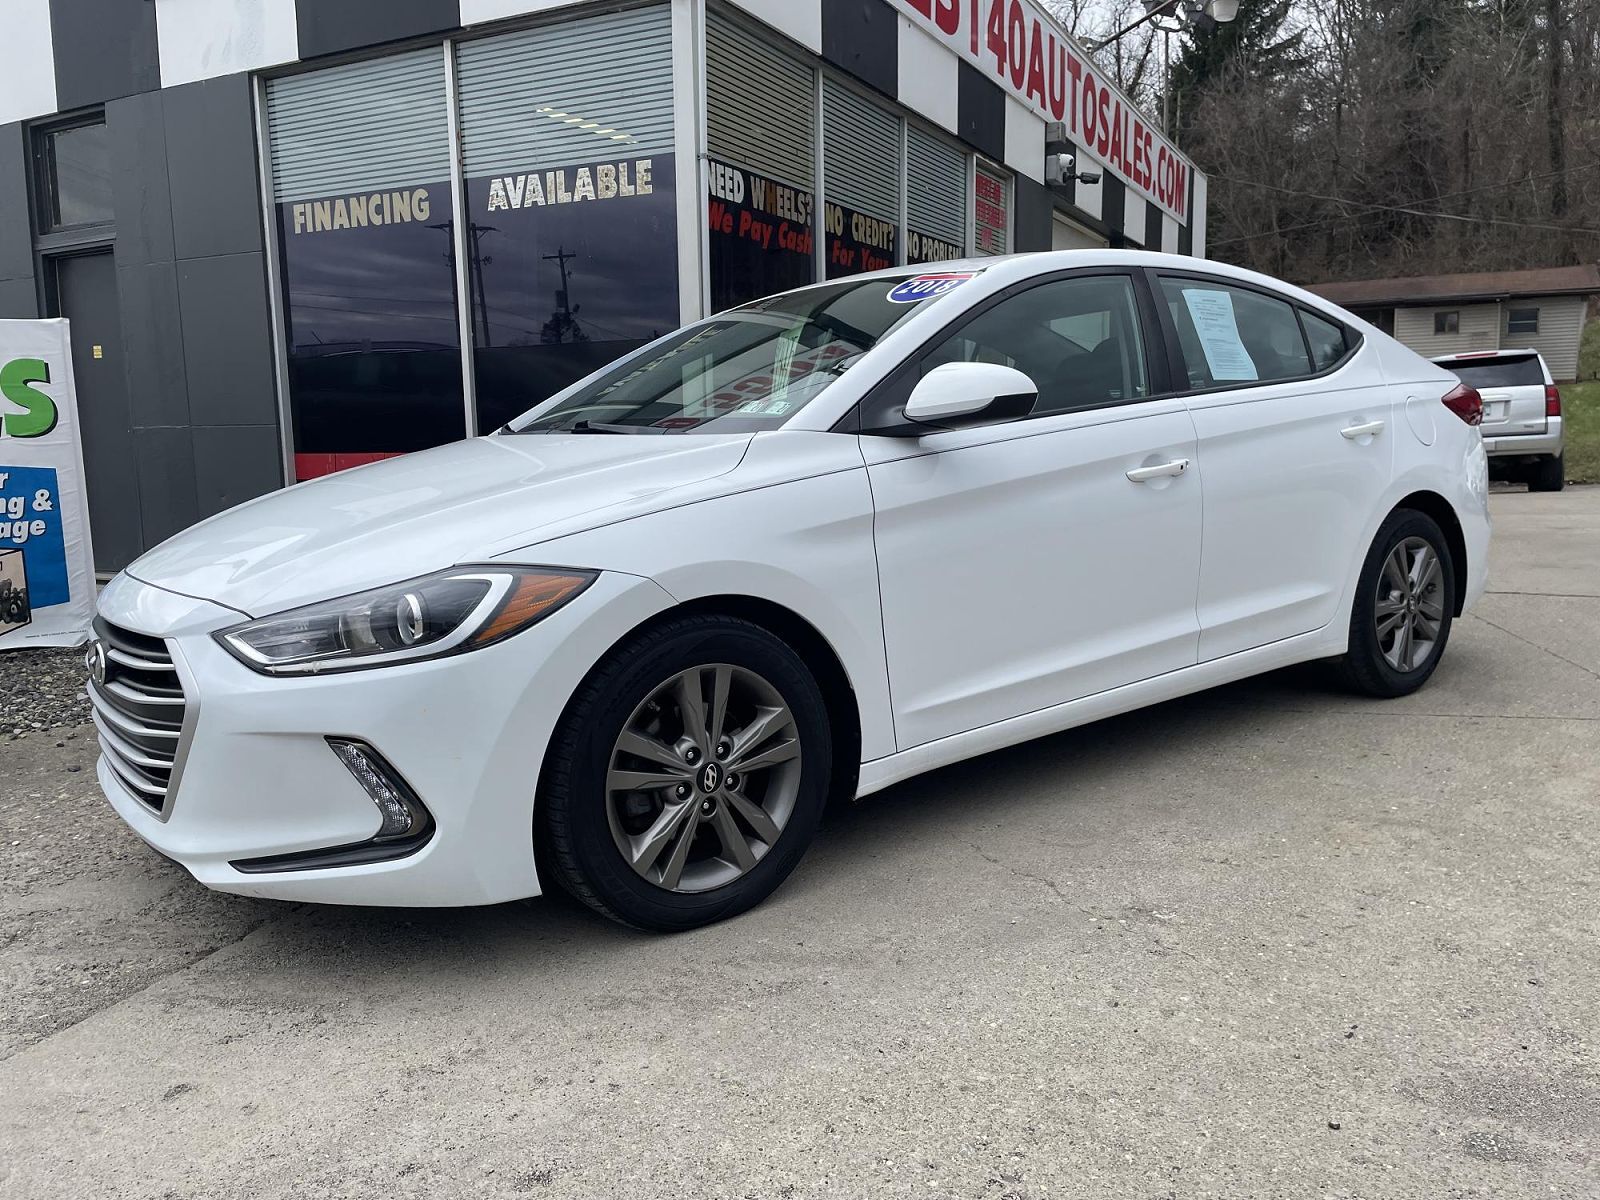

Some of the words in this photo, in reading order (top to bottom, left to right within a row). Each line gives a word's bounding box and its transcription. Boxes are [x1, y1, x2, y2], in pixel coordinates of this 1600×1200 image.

[904, 0, 1186, 217] 140AUTOSALES.COM
[293, 188, 430, 235] FINANCING
[487, 159, 653, 212] AVAILABLE
[708, 160, 744, 204] NEED
[750, 175, 813, 226] WHEELS?
[709, 201, 733, 234] We
[739, 210, 773, 249] Pay
[778, 222, 813, 255] Cash
[825, 203, 843, 237] NO
[851, 212, 895, 252] CREDIT?
[907, 231, 919, 259] NO
[832, 239, 855, 267] For
[896, 280, 960, 295] 2018
[32, 489, 53, 511] &
